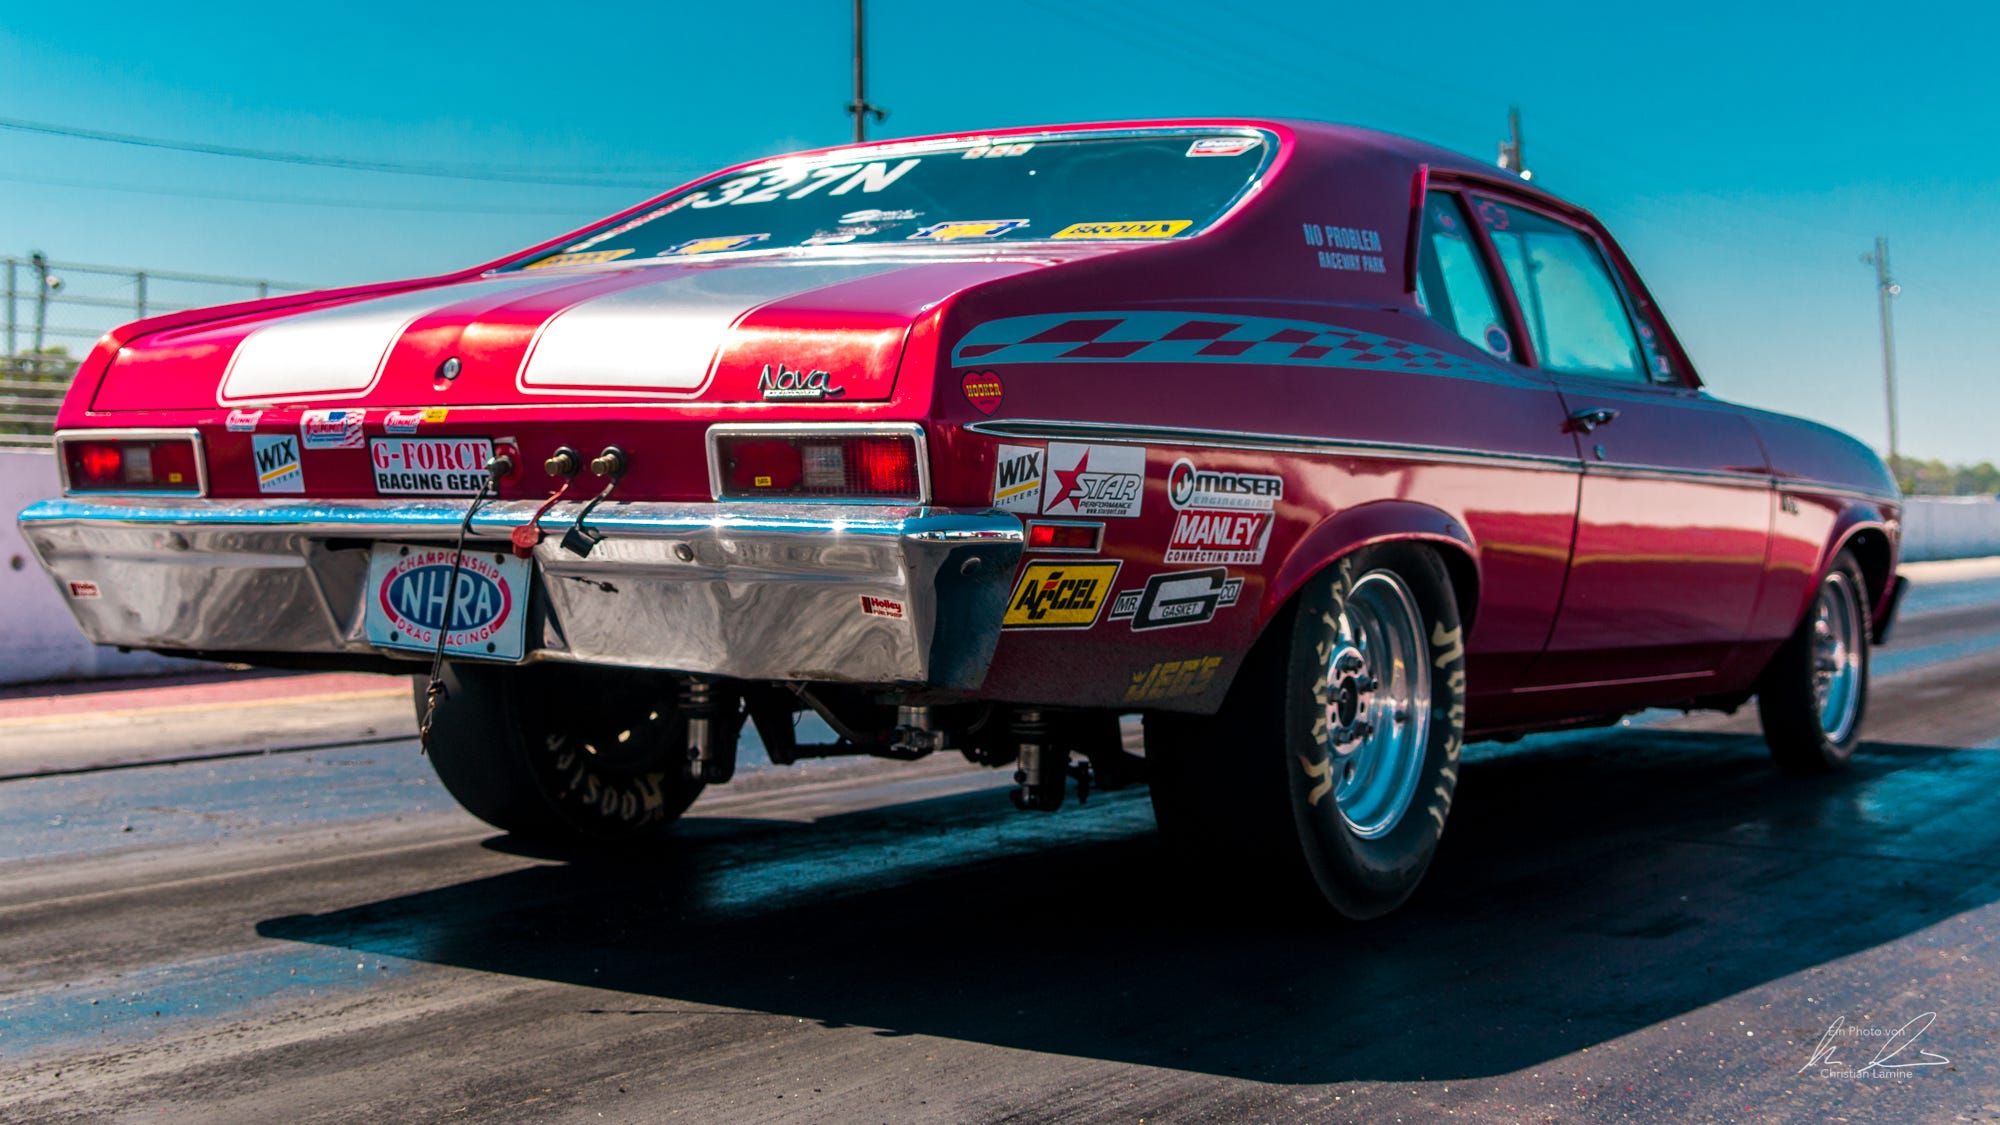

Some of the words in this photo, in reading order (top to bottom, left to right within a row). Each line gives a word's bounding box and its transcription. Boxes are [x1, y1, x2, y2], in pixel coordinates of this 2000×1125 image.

[1303, 223, 1324, 246] NO
[1325, 225, 1382, 252] PROBLEM
[1318, 251, 1361, 271] RACEWAY
[1361, 255, 1387, 273] PARK
[757, 363, 845, 396] Nova
[966, 383, 1002, 397] HOOKER
[257, 438, 296, 473] WIX
[373, 442, 489, 470] G-FORCE
[378, 473, 443, 490] RACING
[999, 452, 1040, 488] WIX
[1068, 472, 1143, 501] STAR
[1195, 474, 1281, 496] MOSER
[995, 488, 1039, 508] FILTERS
[1080, 501, 1133, 509] PERFORMANCE
[1174, 514, 1261, 545] MANLEY
[1167, 552, 1230, 562] CONNECTING
[1234, 552, 1258, 562] RODS
[401, 571, 493, 626] NHRA
[872, 597, 902, 613] Holley
[1162, 602, 1198, 618] GASKET
[396, 619, 432, 643] DRAG
[438, 626, 489, 646] ACING
